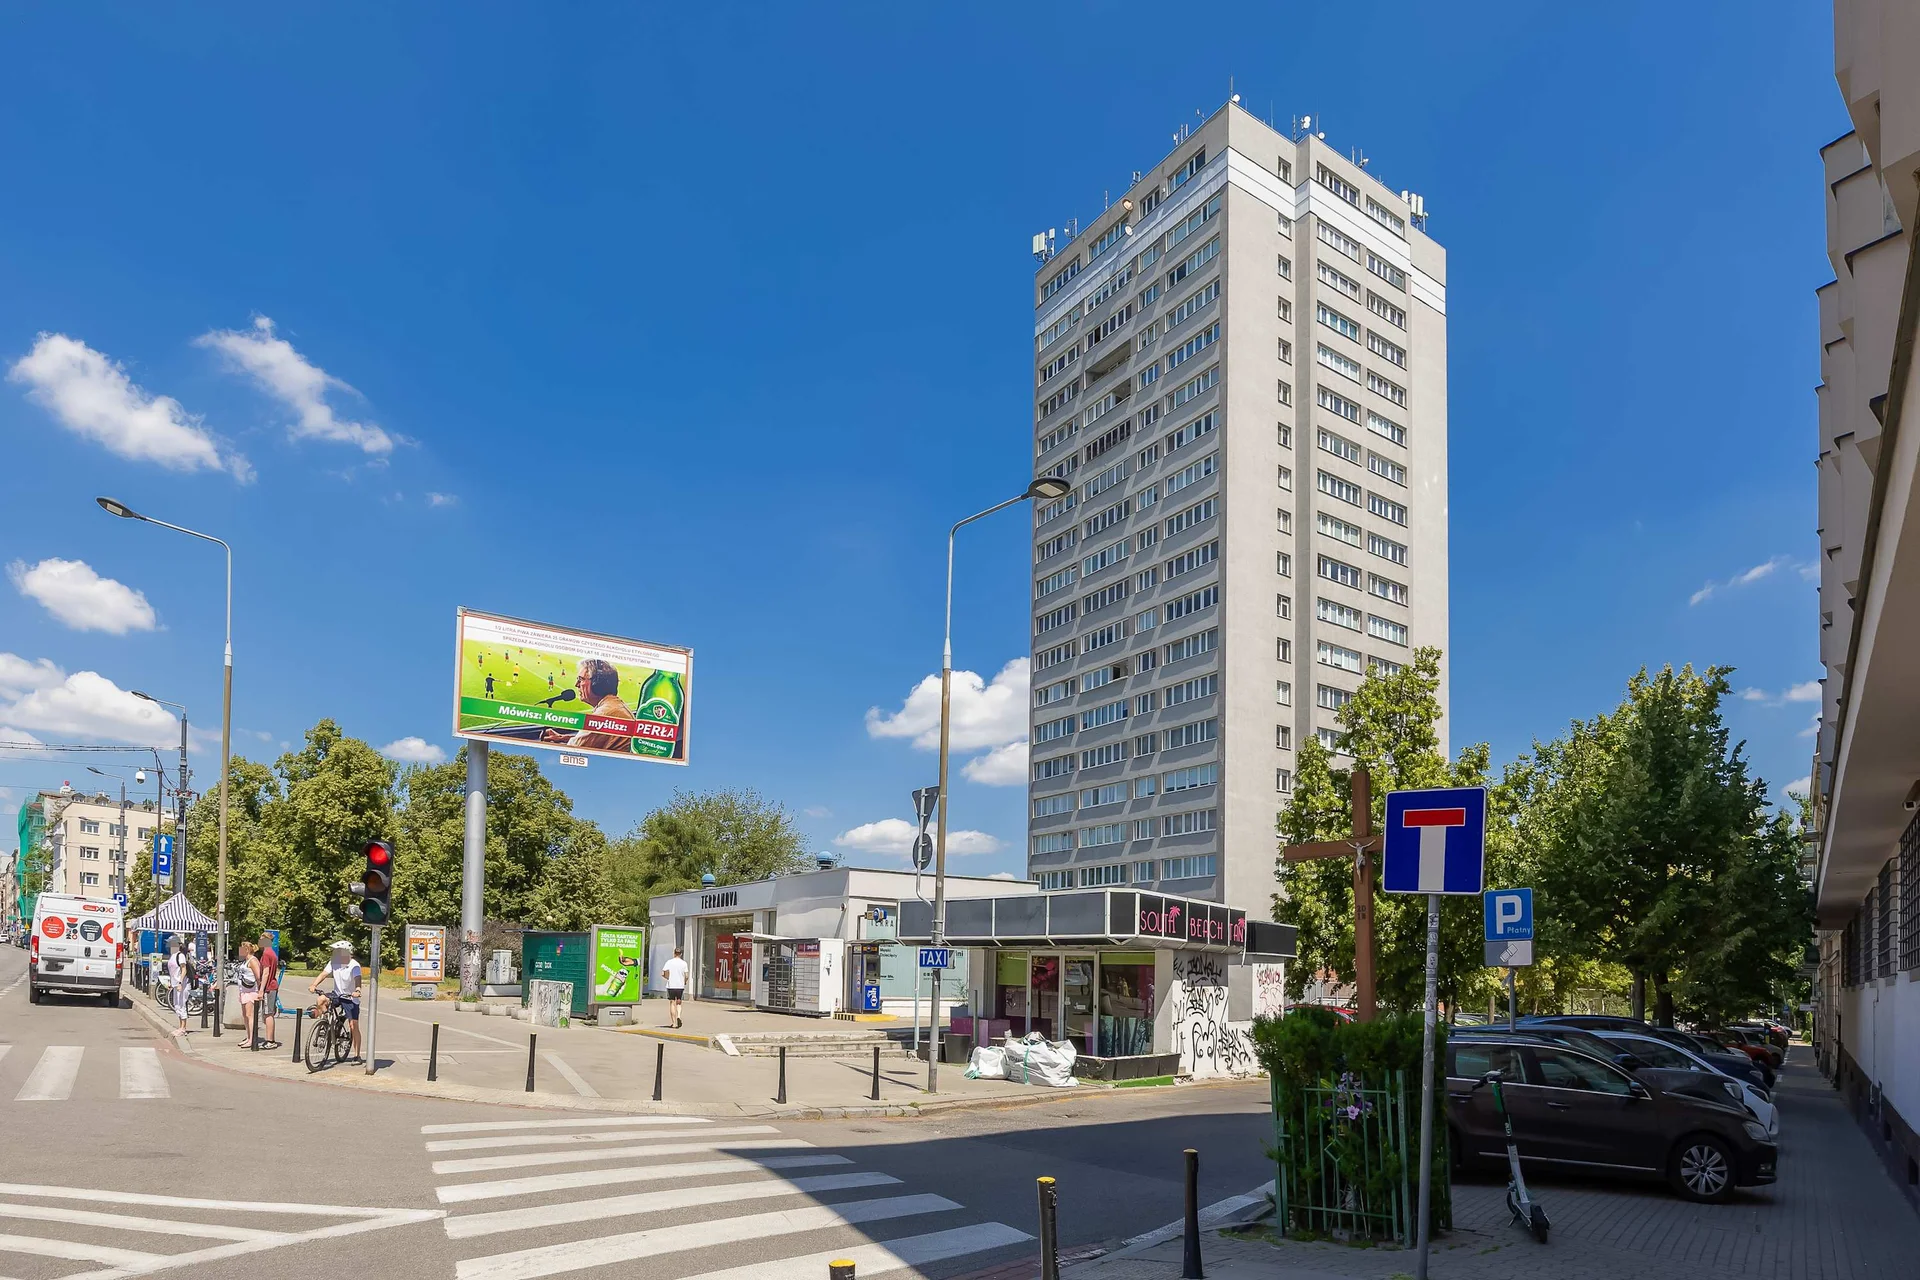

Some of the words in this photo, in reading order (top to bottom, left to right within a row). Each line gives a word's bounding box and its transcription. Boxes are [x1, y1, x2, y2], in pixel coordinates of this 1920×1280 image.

[498, 705, 542, 720] Mówisz:
[545, 712, 579, 725] Korner
[588, 718, 628, 732] myślisz:
[636, 723, 674, 738] PERŁA
[562, 755, 586, 765] ams
[701, 891, 738, 909] TERRANOVA
[1356, 904, 1367, 912] 20
[1495, 894, 1523, 935] P
[1140, 908, 1178, 934] SOUTH
[1189, 917, 1223, 940] BEACH
[1229, 920, 1245, 943] TAN
[1506, 926, 1532, 935] Płatny
[920, 951, 947, 965] TAXI
